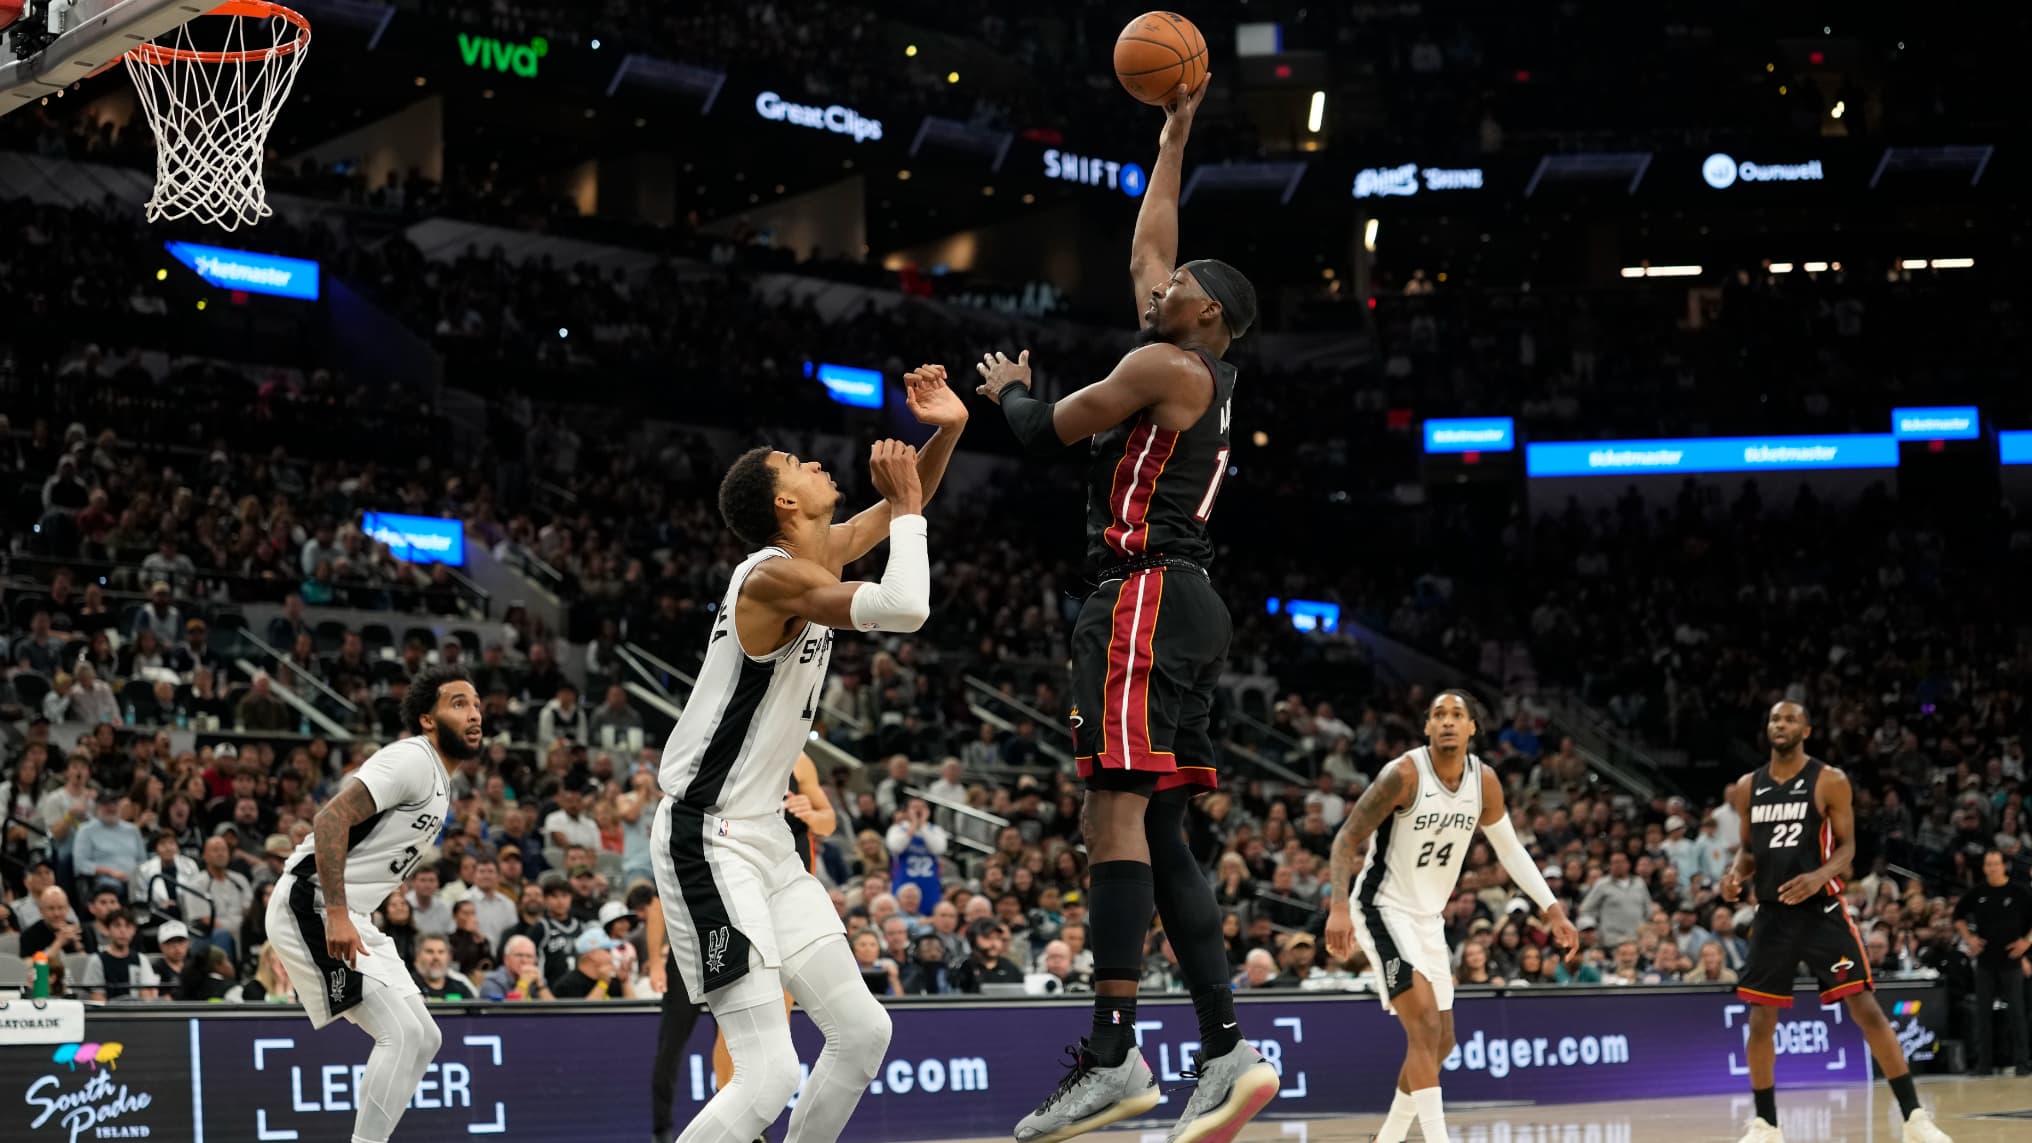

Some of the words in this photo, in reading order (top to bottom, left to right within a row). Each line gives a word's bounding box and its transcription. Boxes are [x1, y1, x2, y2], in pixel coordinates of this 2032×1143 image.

[1588, 449, 1683, 468] ticketmaster
[1744, 445, 1837, 463] ticketmaster
[1414, 812, 1476, 835] SPURS
[1751, 802, 1808, 823] MIAMI
[1769, 822, 1803, 848] 22
[1417, 841, 1455, 868] 24
[905, 855, 934, 878] 32
[0, 1017, 61, 1029] ATORADE
[1442, 1030, 1630, 1078] edger.com
[25, 1067, 116, 1129] South
[291, 1062, 471, 1111] LEER
[61, 1084, 152, 1143] Padre
[95, 1125, 150, 1138] ISLAND
